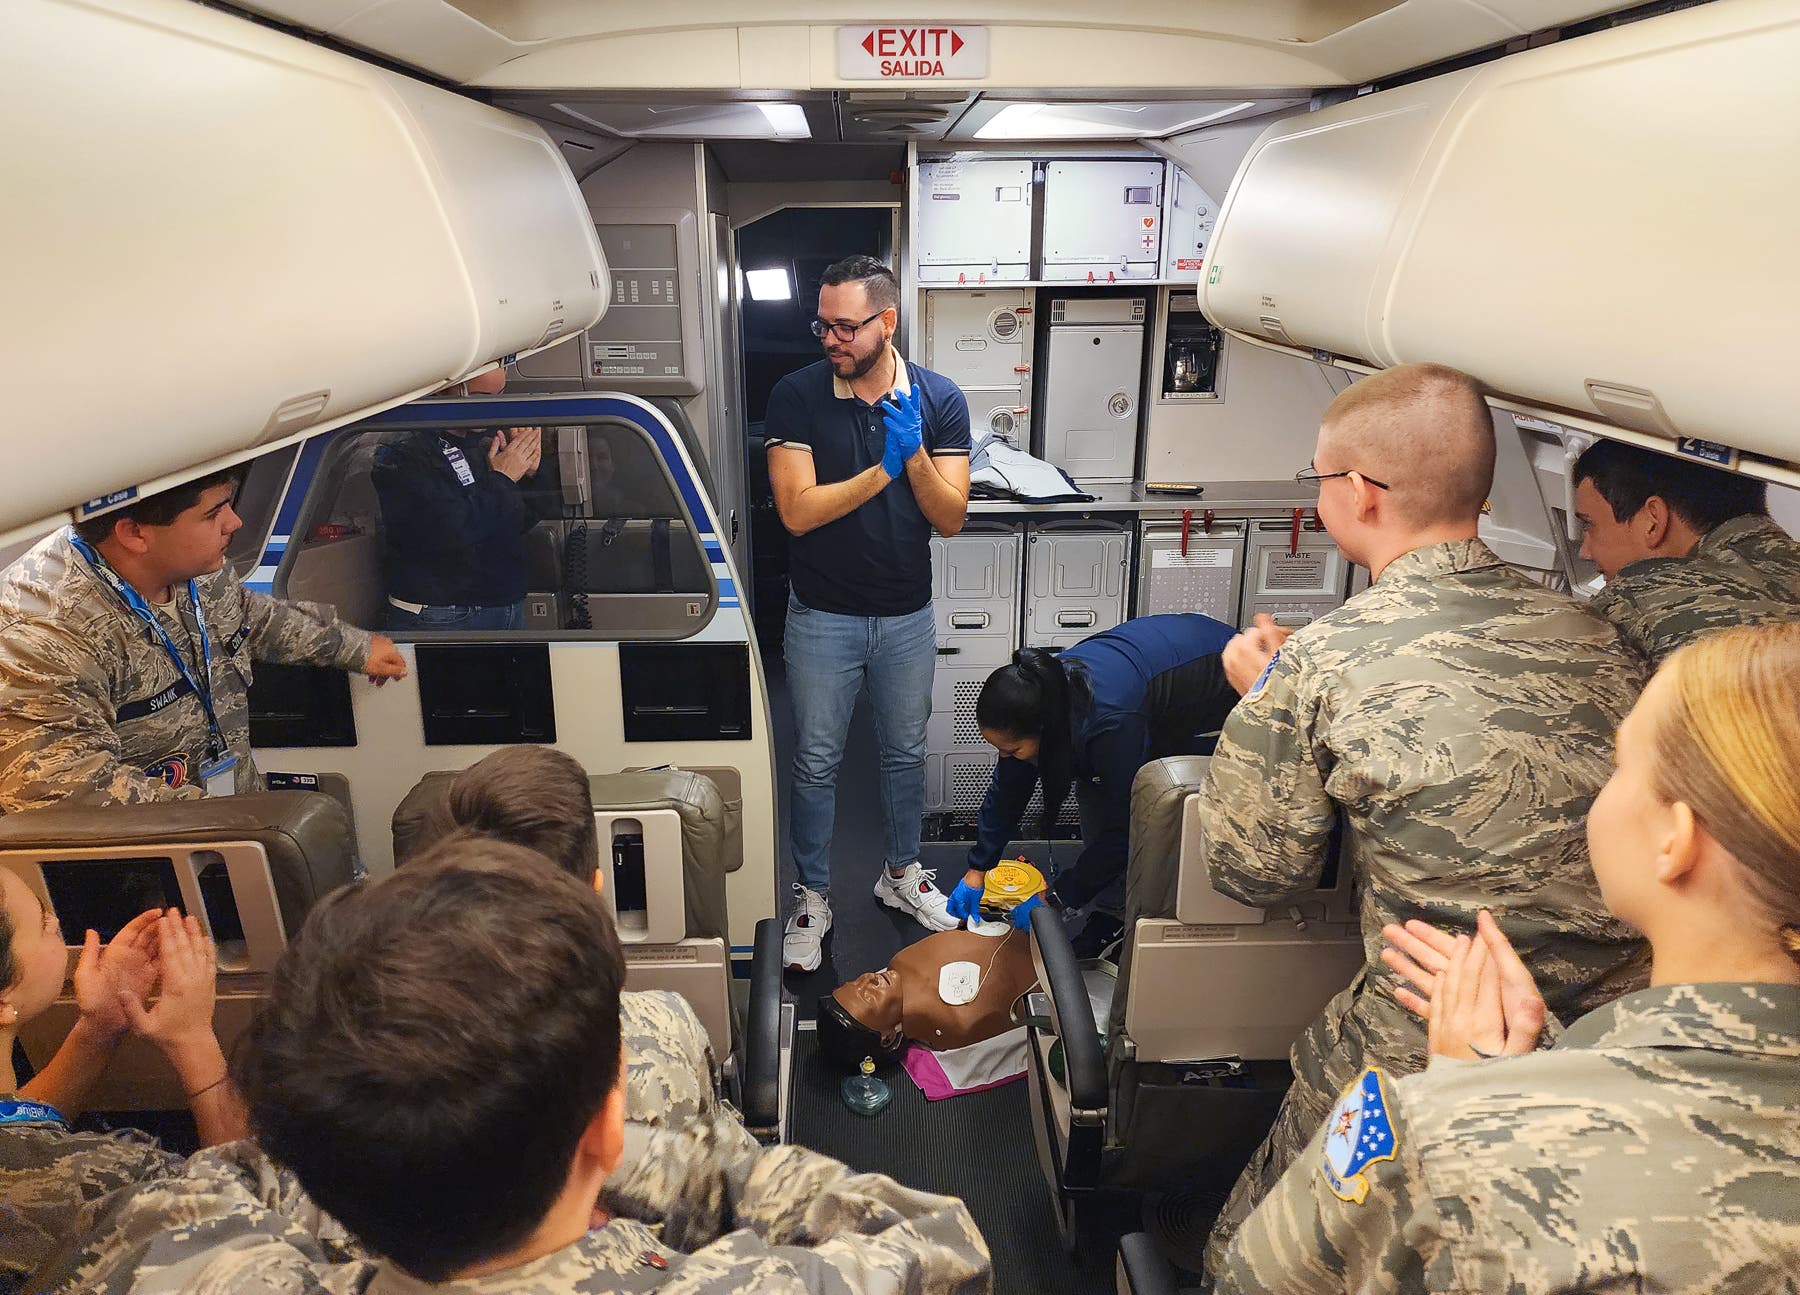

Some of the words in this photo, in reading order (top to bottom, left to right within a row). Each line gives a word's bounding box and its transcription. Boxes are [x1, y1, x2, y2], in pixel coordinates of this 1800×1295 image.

[878, 28, 948, 57] EXIT
[880, 60, 945, 76] SALIDA
[150, 687, 178, 711] SWANK
